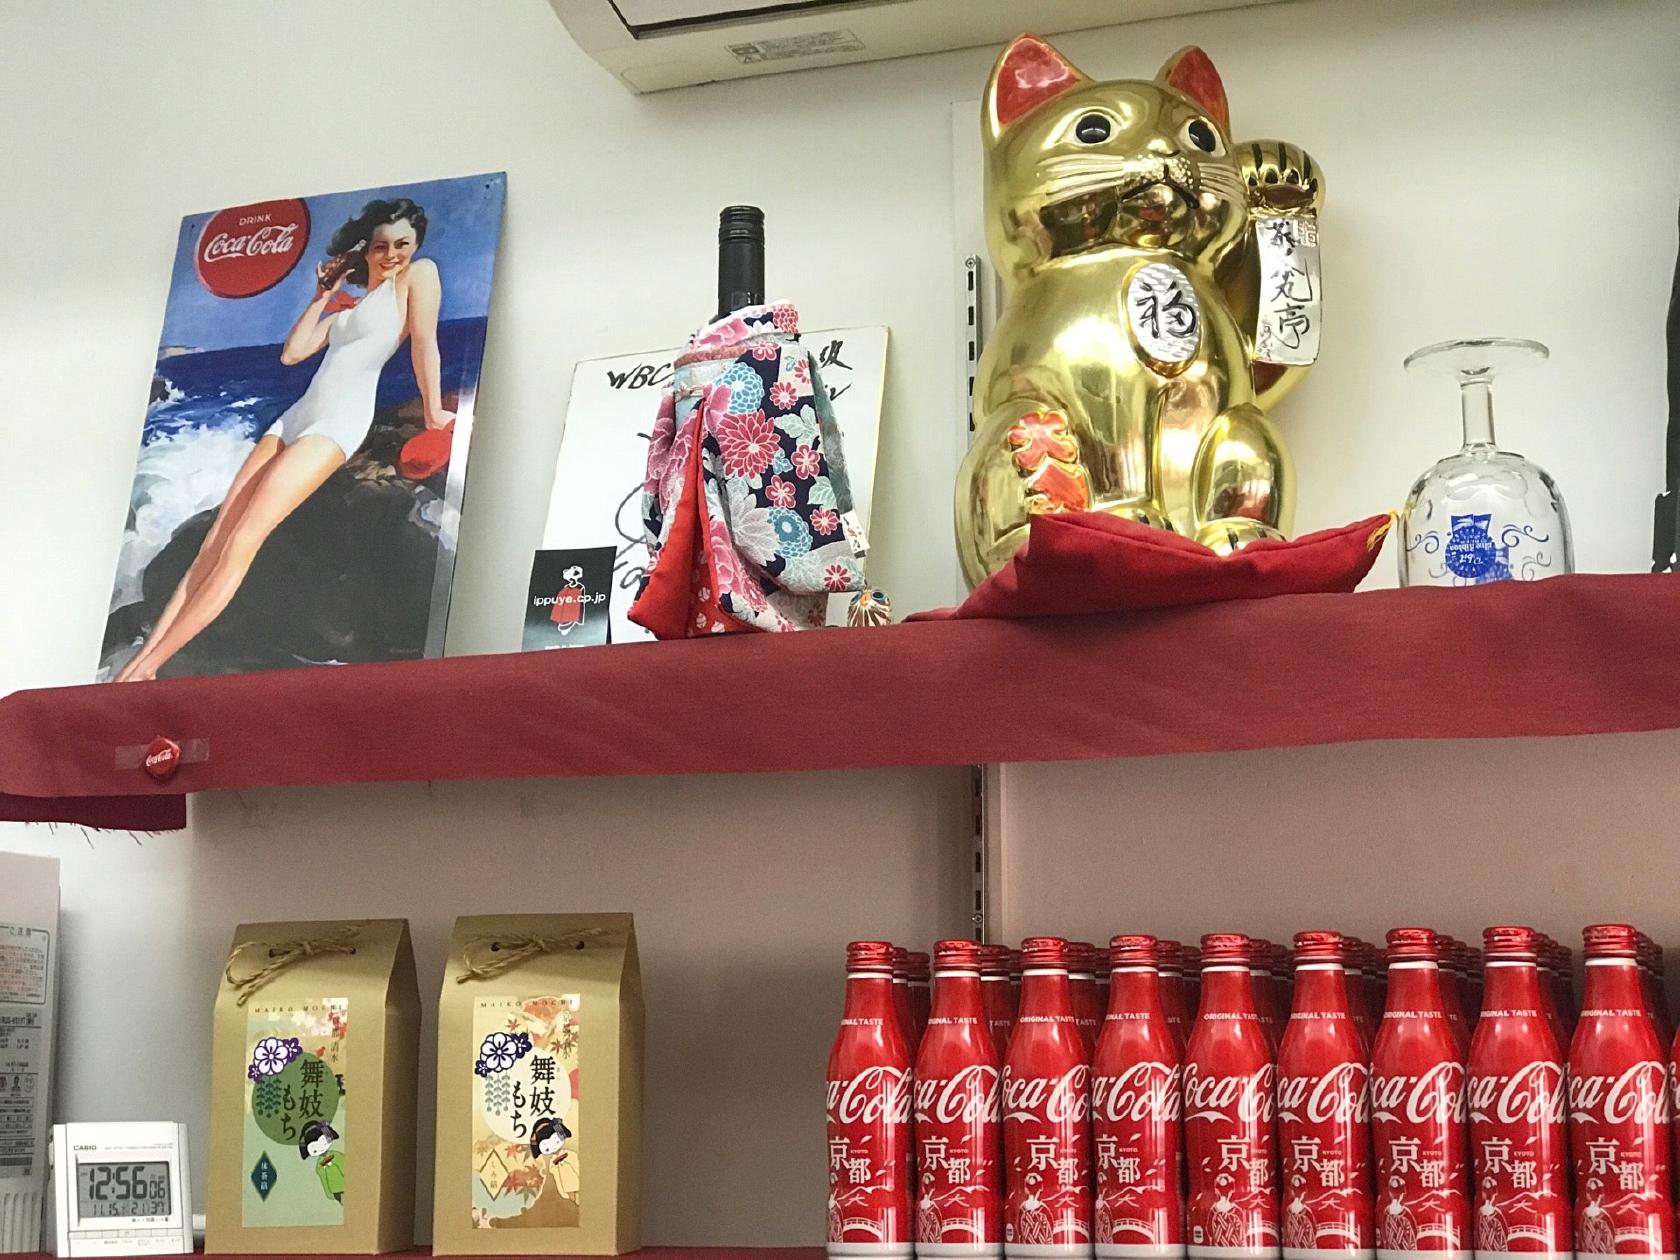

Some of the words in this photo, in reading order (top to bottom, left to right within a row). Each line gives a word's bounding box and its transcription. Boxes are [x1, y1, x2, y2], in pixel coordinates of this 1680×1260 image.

[239, 213, 272, 226] DRINK
[1135, 280, 1197, 339] 福
[606, 361, 675, 390] WBC
[533, 592, 606, 606] ippuya.co.jp
[1204, 1012, 1241, 1020] ORIGINAL
[1321, 1011, 1346, 1019] TASTE
[1419, 1010, 1442, 1018] TASTE
[1512, 1009, 1537, 1017] TASTE
[1617, 1009, 1642, 1017] TASTE
[300, 1059, 325, 1118] 舞妓
[510, 1080, 527, 1138] もち
[529, 1055, 556, 1116] 舞妓
[280, 1084, 296, 1140] もち
[89, 1166, 147, 1200] 12:56
[149, 1180, 165, 1199] 06
[829, 1136, 871, 1184] 京都
[922, 1135, 970, 1184] 京都
[1026, 1135, 1079, 1184] 京都
[1096, 1133, 1140, 1184] 京都
[1217, 1135, 1268, 1192] 京都
[1291, 1136, 1345, 1187] 京都
[1388, 1136, 1446, 1188] 京都
[1481, 1137, 1538, 1189] 京都
[1585, 1137, 1644, 1190] 京都
